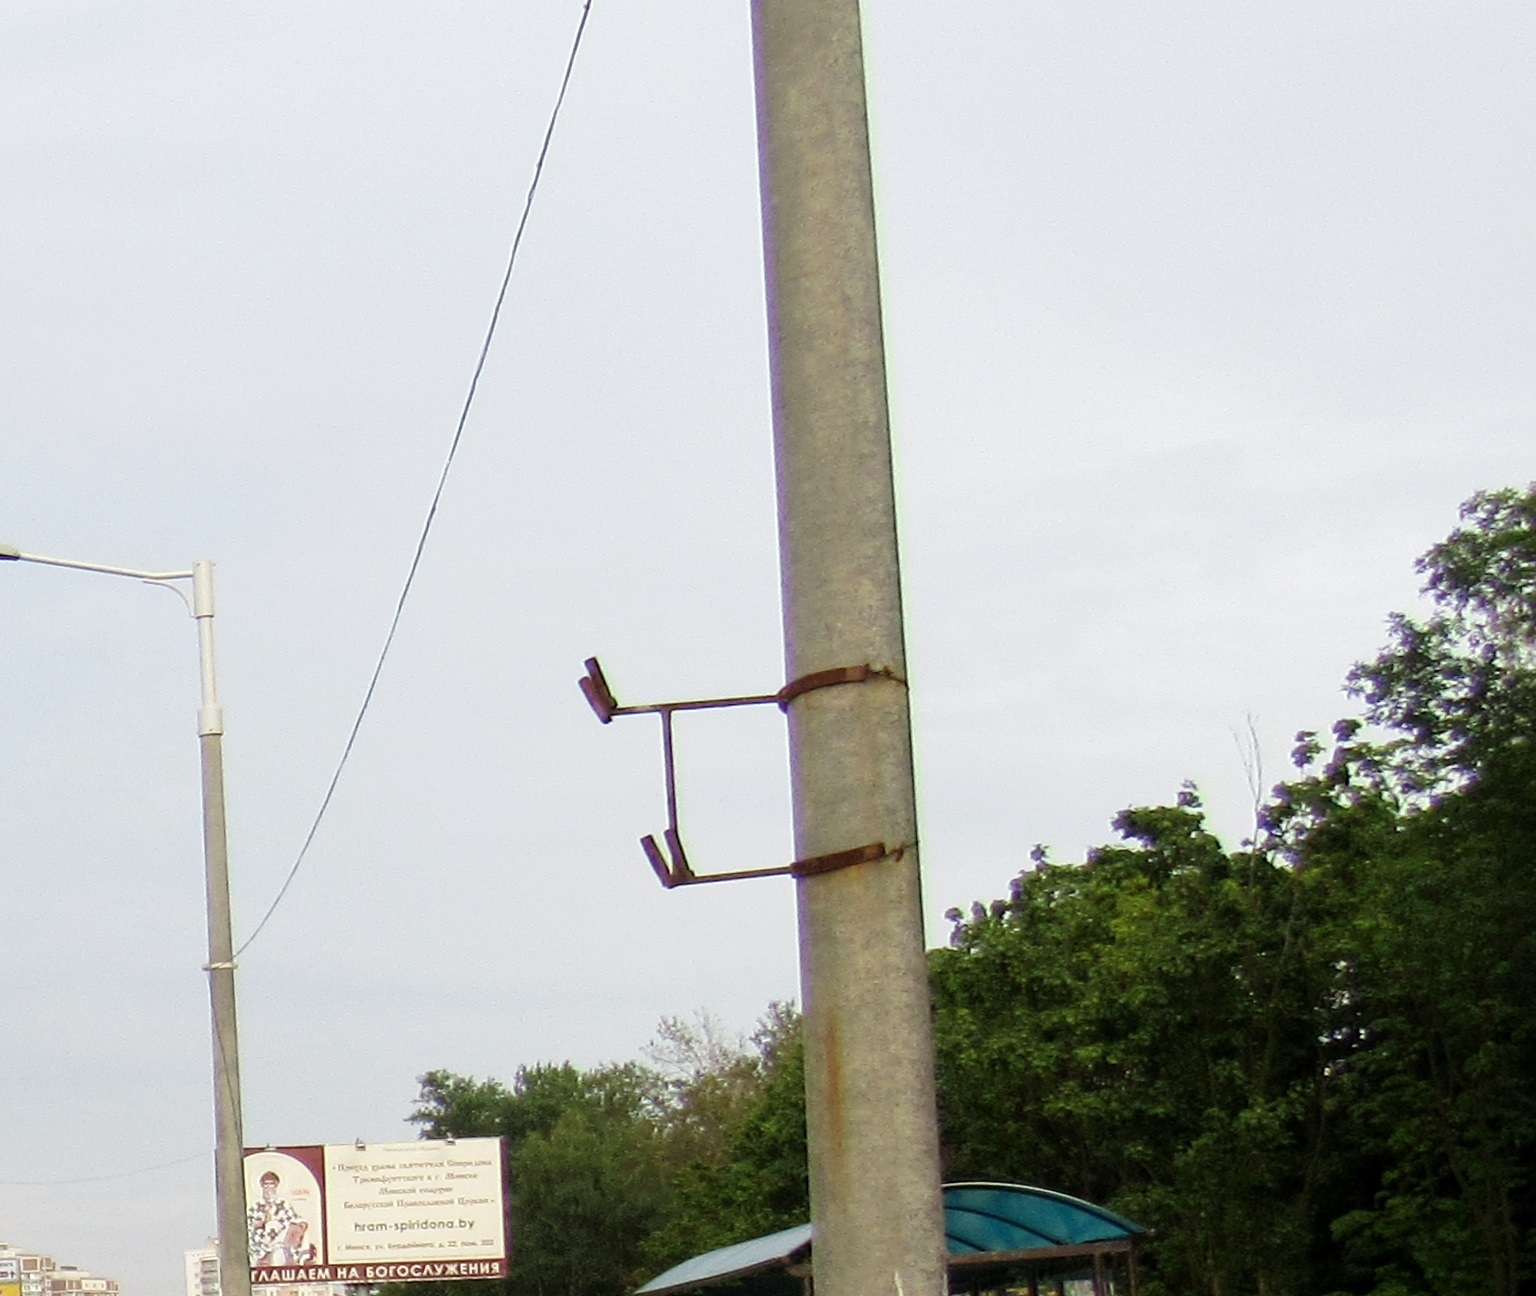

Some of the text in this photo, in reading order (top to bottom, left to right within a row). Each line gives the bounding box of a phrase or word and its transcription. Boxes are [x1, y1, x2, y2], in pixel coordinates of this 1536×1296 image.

[354, 1219, 475, 1232] hram-spiridona.by
[251, 1262, 501, 1283] ГЛАШАЕМ НА БОГОСЛУЖЕНИЯ
